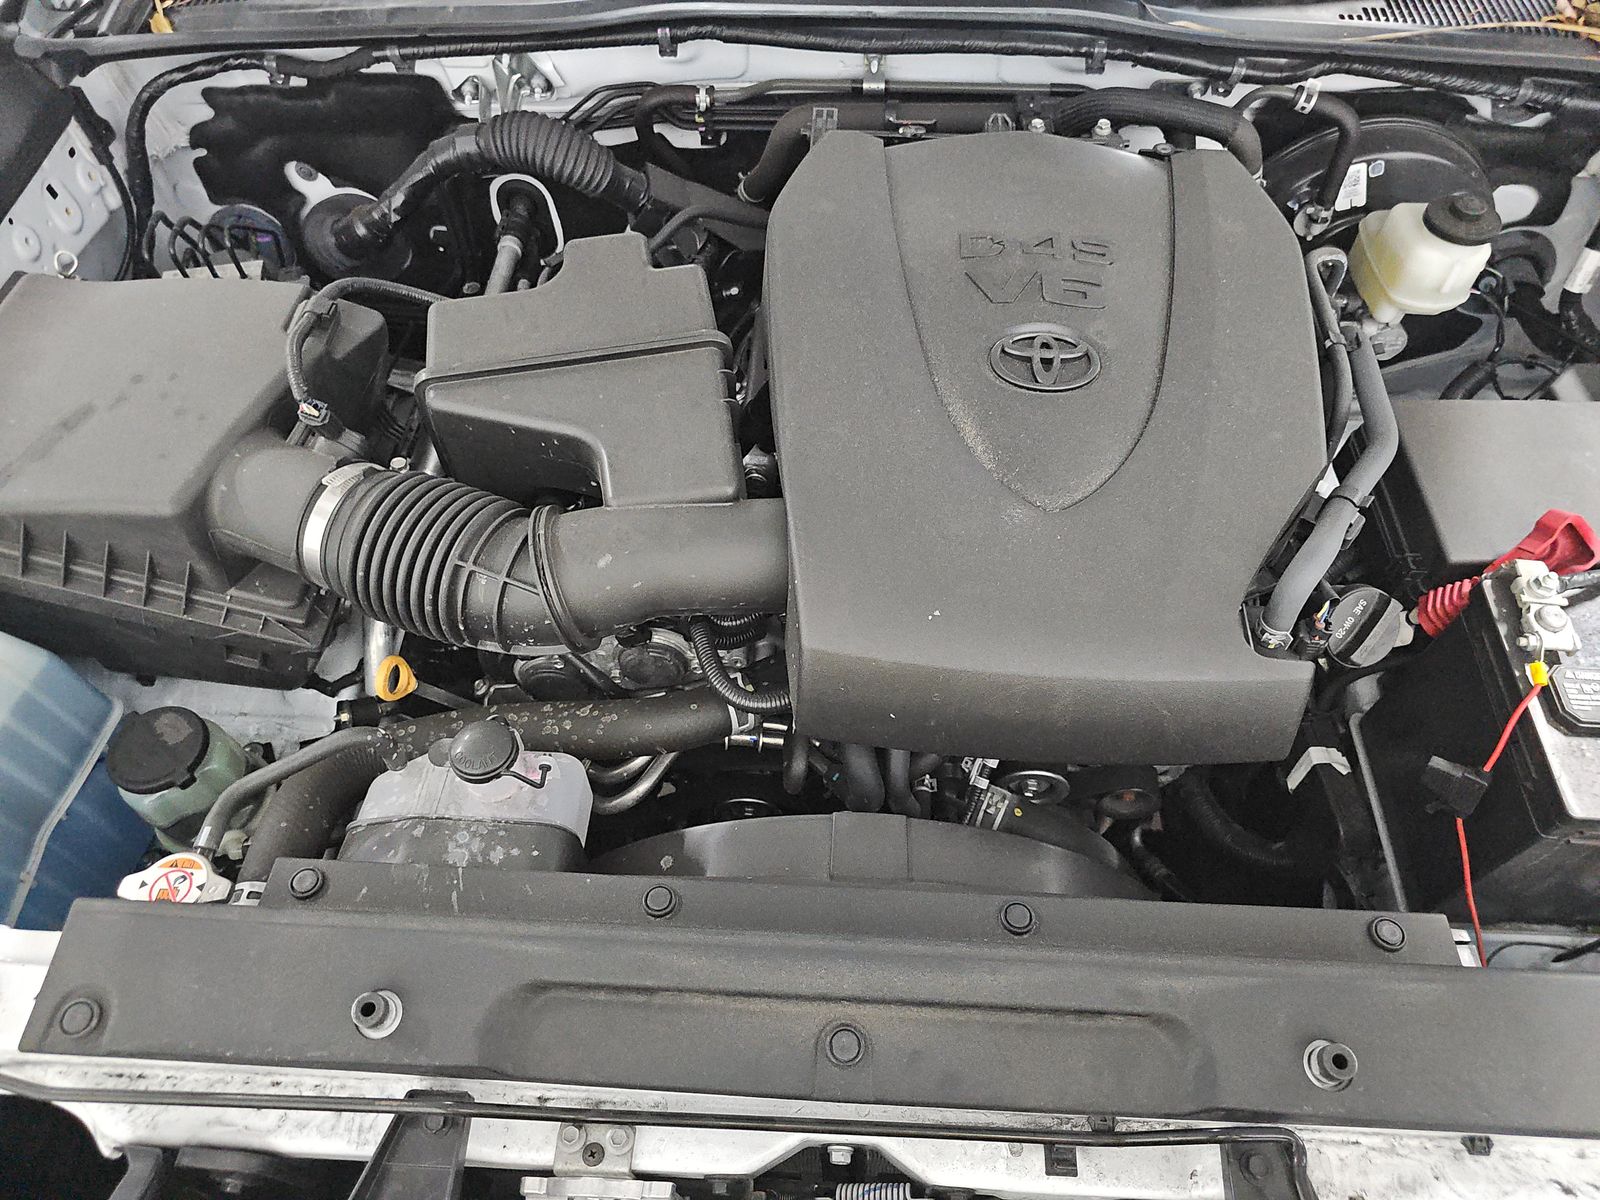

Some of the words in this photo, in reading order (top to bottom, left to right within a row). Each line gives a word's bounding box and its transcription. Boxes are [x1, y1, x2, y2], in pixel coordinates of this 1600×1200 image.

[963, 270, 1107, 310] V6
[1353, 598, 1368, 616] SAE
[1335, 616, 1355, 639] 0W-20
[454, 750, 498, 770] COOLANT
